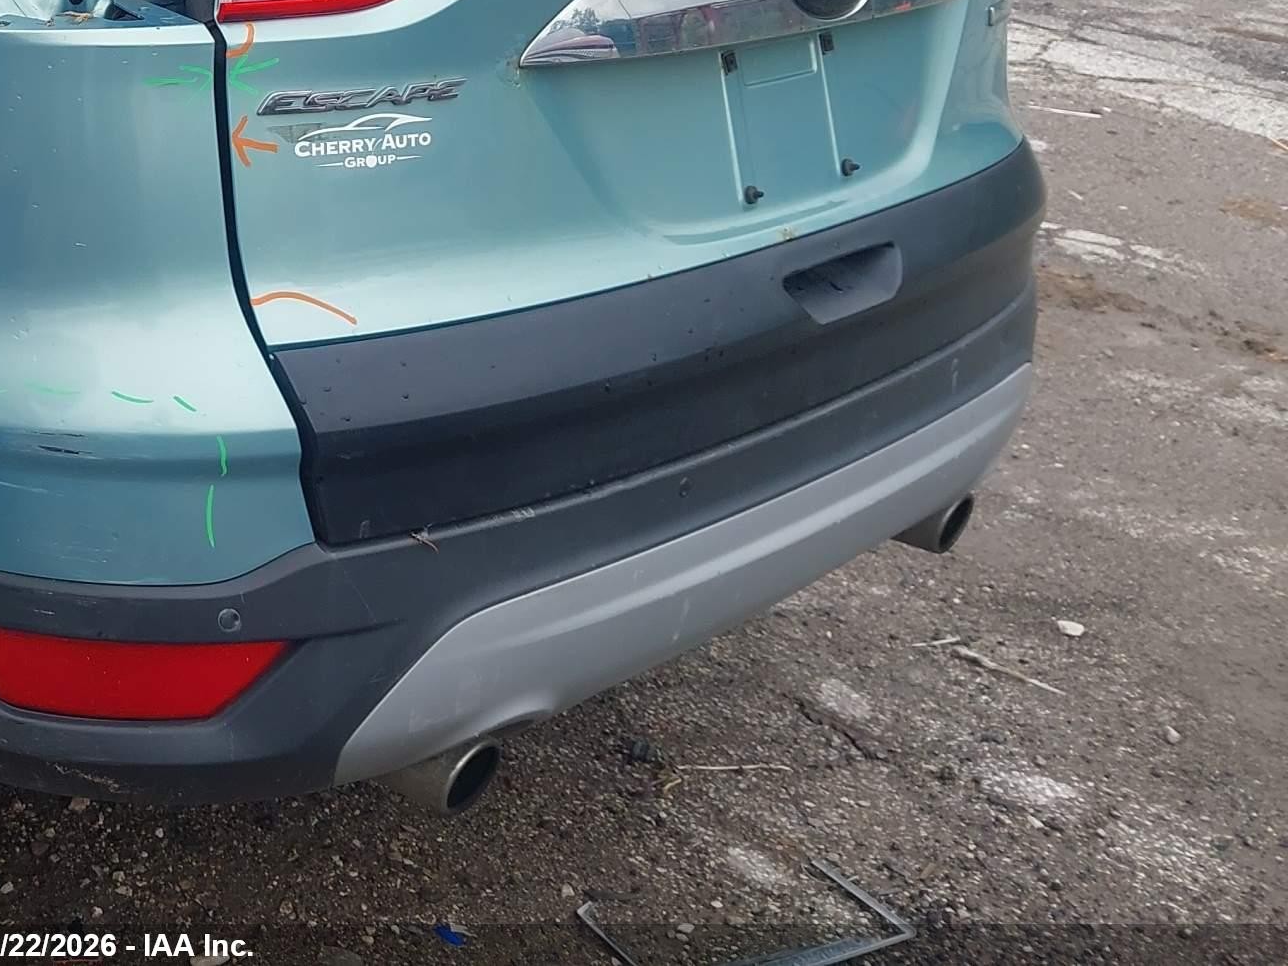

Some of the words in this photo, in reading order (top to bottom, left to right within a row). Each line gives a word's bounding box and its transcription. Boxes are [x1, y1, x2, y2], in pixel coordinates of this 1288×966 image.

[256, 77, 467, 116] ESCAPE
[294, 137, 377, 158] CHERRY
[381, 132, 432, 150] AUTO
[344, 154, 396, 169] GROUP
